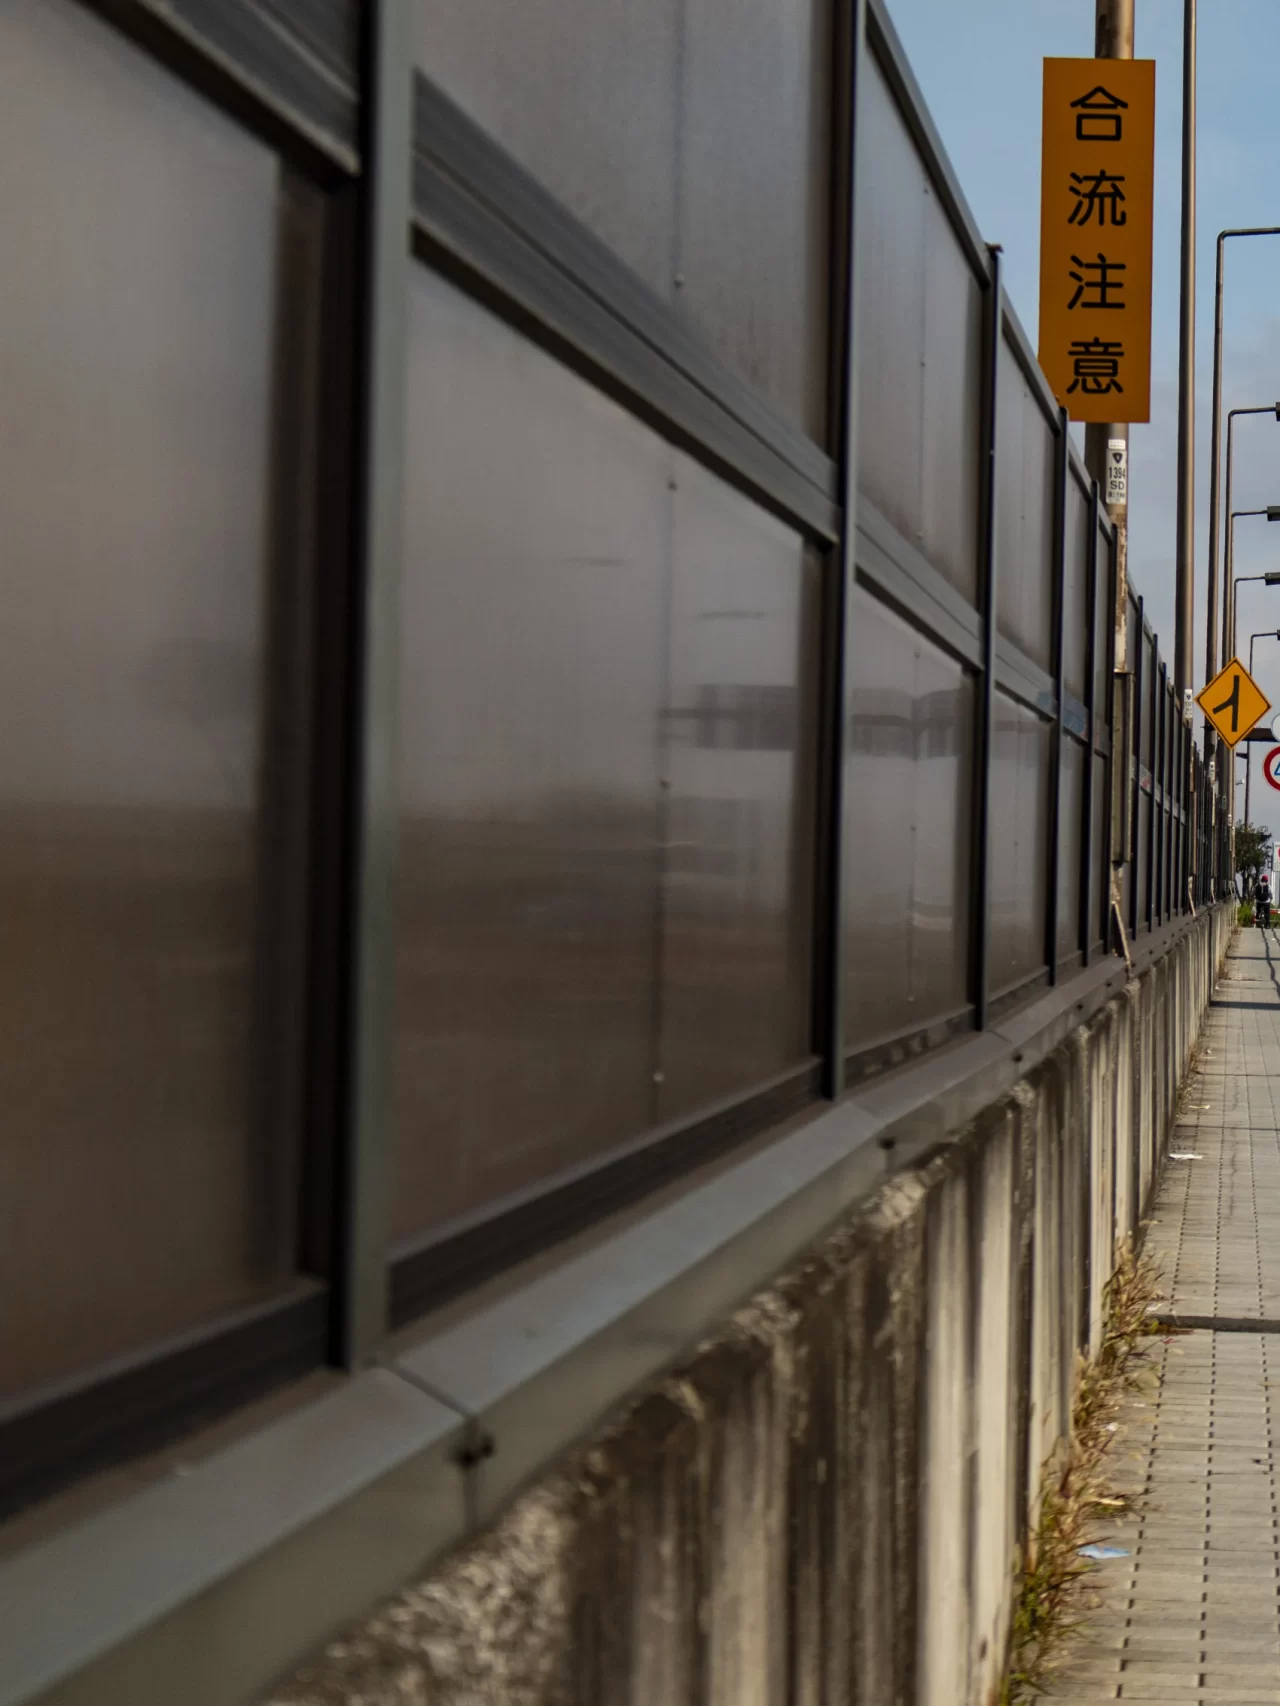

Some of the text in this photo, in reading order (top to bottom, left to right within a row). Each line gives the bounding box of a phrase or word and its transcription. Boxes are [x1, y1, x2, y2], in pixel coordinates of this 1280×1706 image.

[1066, 85, 1129, 395] 合流注意
[1110, 480, 1125, 490] SD
